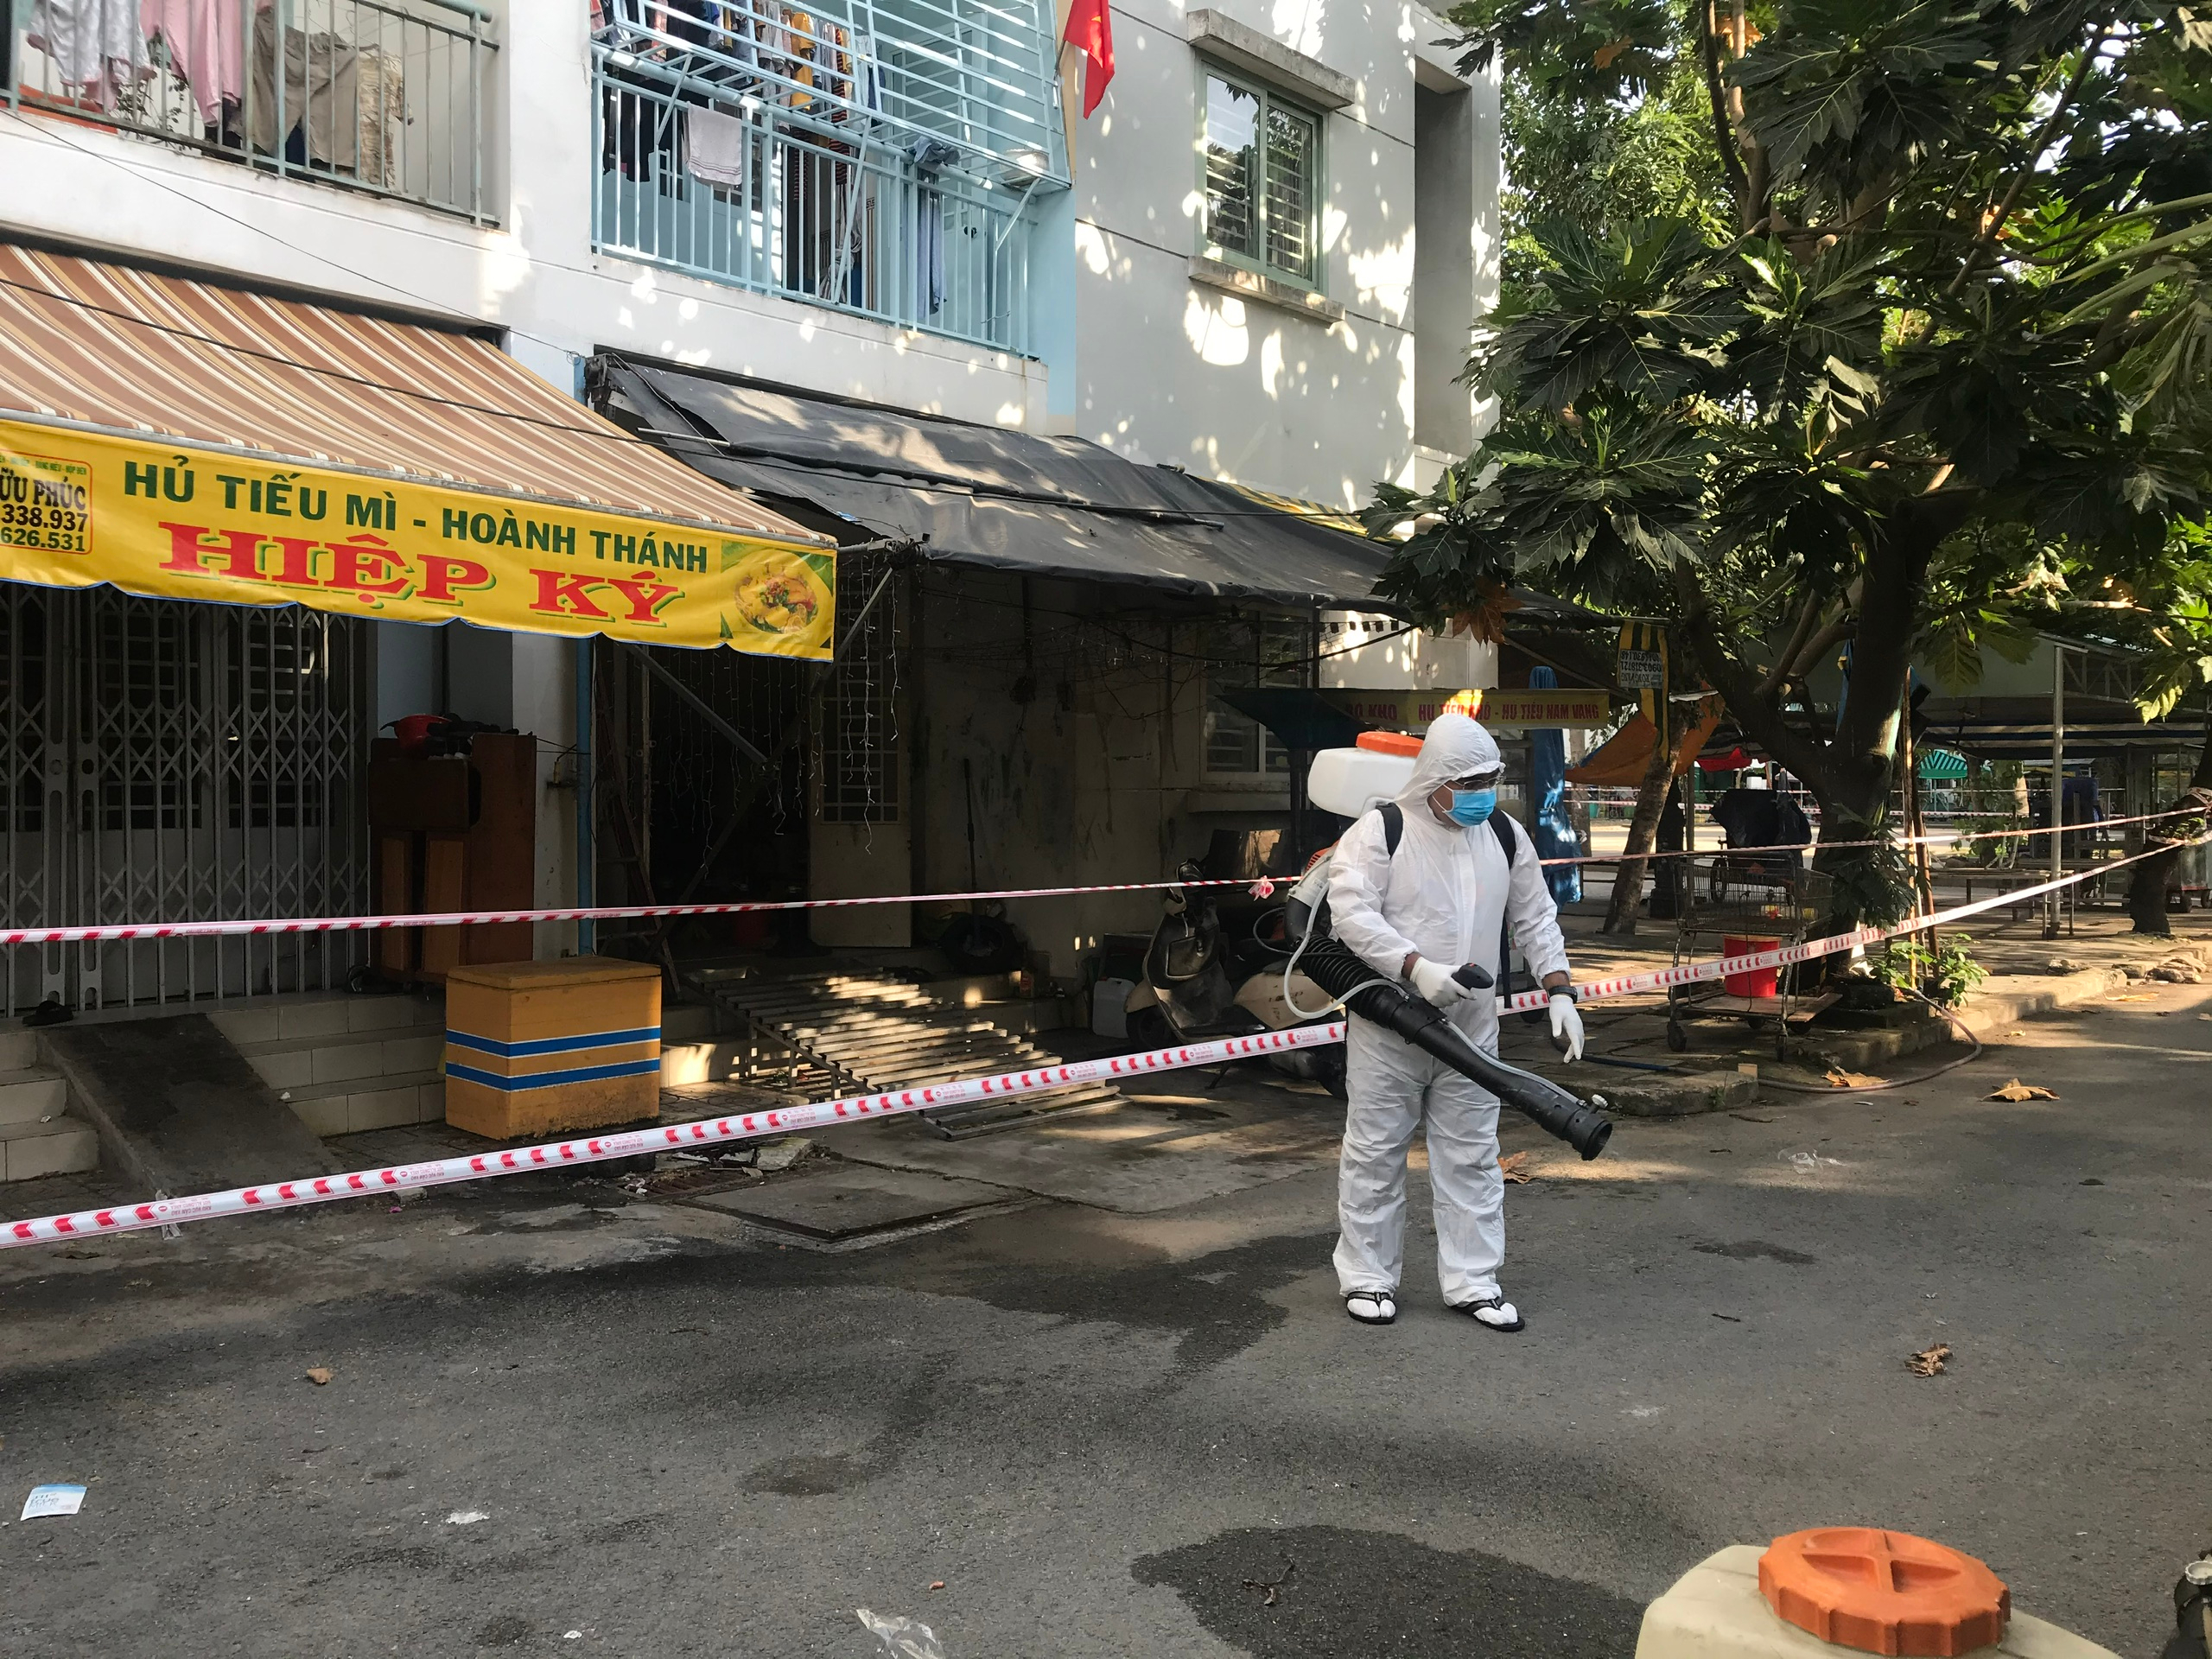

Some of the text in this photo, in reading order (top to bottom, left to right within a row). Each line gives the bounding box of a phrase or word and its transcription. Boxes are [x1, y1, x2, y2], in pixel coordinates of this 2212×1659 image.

[33, 476, 86, 511] PHÚC
[124, 455, 194, 503] HỦ
[216, 474, 327, 520] TIẾU
[346, 491, 397, 531] MÌ
[442, 508, 575, 556] HOÀNH
[589, 531, 708, 573] THÁNH
[159, 521, 681, 623] HIỆP KÝ
[1546, 703, 1570, 720] NAM
